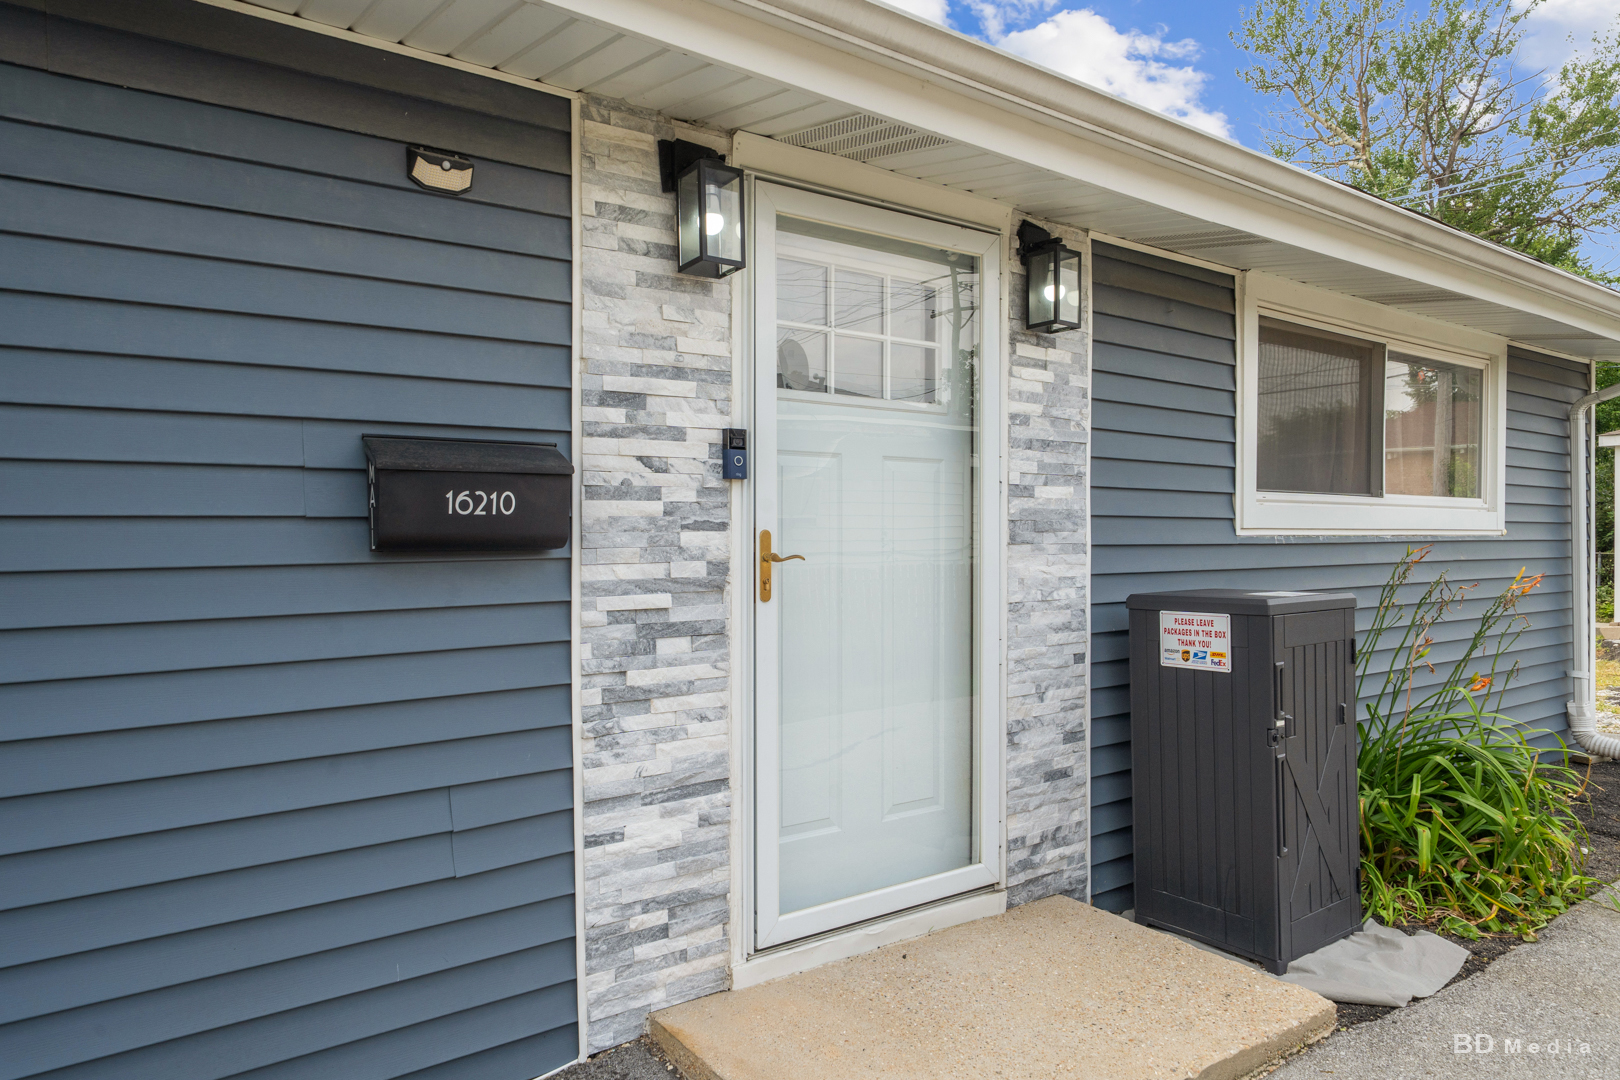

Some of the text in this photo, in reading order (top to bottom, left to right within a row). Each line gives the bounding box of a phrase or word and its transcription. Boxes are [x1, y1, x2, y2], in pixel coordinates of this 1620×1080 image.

[445, 489, 516, 516] 16210
[1174, 618, 1214, 627] PLEASE LEAVE
[1163, 627, 1226, 639] PACKAGES IN THE BOX
[1177, 638, 1212, 648] THANK YOU!
[1210, 658, 1227, 667] FedEx
